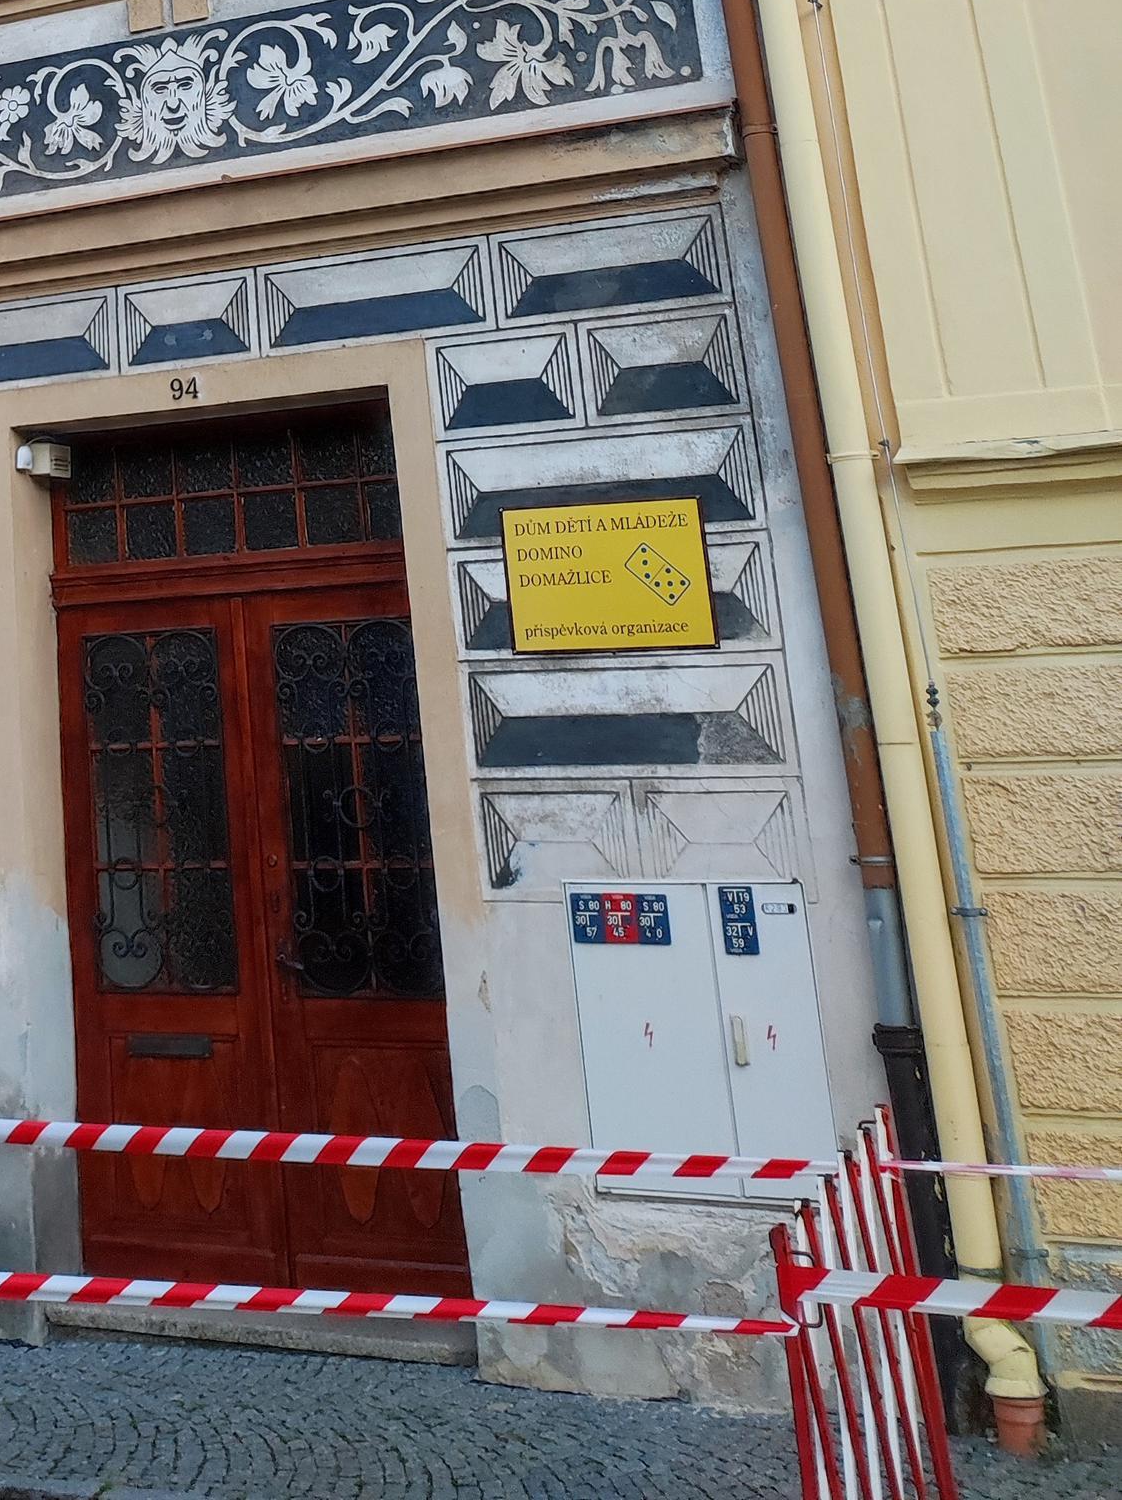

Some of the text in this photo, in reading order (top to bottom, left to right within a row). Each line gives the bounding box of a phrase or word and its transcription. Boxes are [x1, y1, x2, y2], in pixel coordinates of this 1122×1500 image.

[170, 376, 199, 400] 94
[514, 510, 689, 537] DŮM DĚTÍ A MLÁDEŽE
[517, 545, 583, 562] DOMINO
[519, 569, 613, 588] DOMAŽLICE
[525, 619, 689, 641] příspěvková organizace
[653, 901, 665, 912] 80
[733, 904, 746, 914] 53
[732, 938, 745, 948] 59
